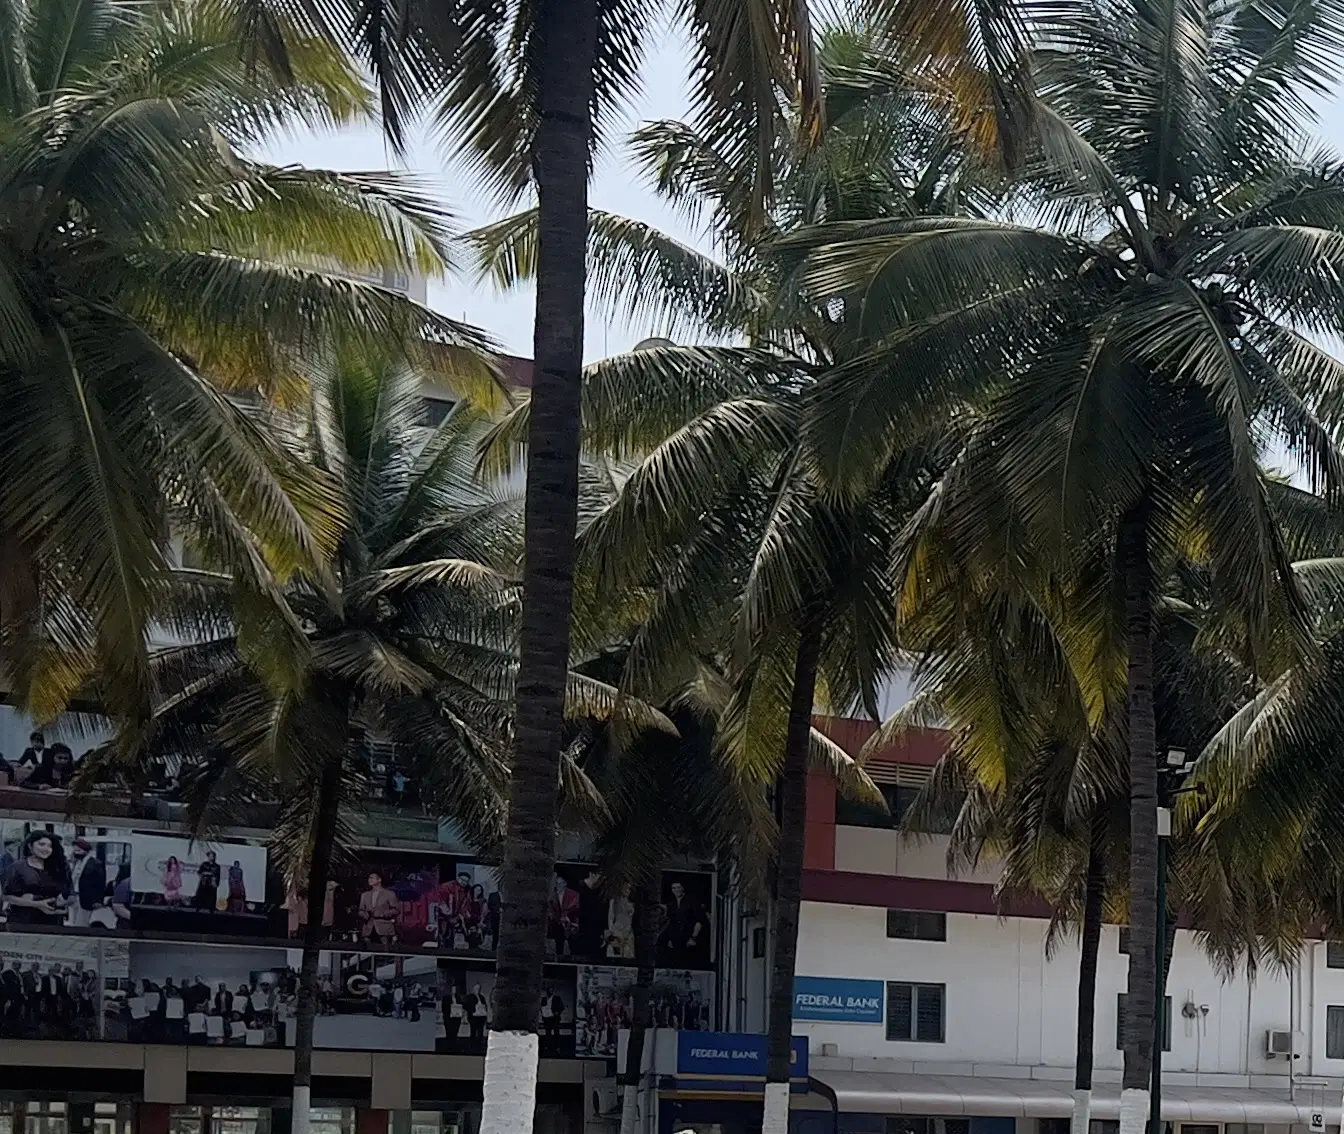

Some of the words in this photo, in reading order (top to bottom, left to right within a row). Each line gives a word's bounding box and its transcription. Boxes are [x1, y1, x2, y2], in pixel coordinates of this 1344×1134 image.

[796, 994, 843, 1007] FEDERAL
[846, 997, 880, 1009] BANK
[691, 1048, 729, 1059] FEDERAL
[732, 1050, 759, 1060] BANK
